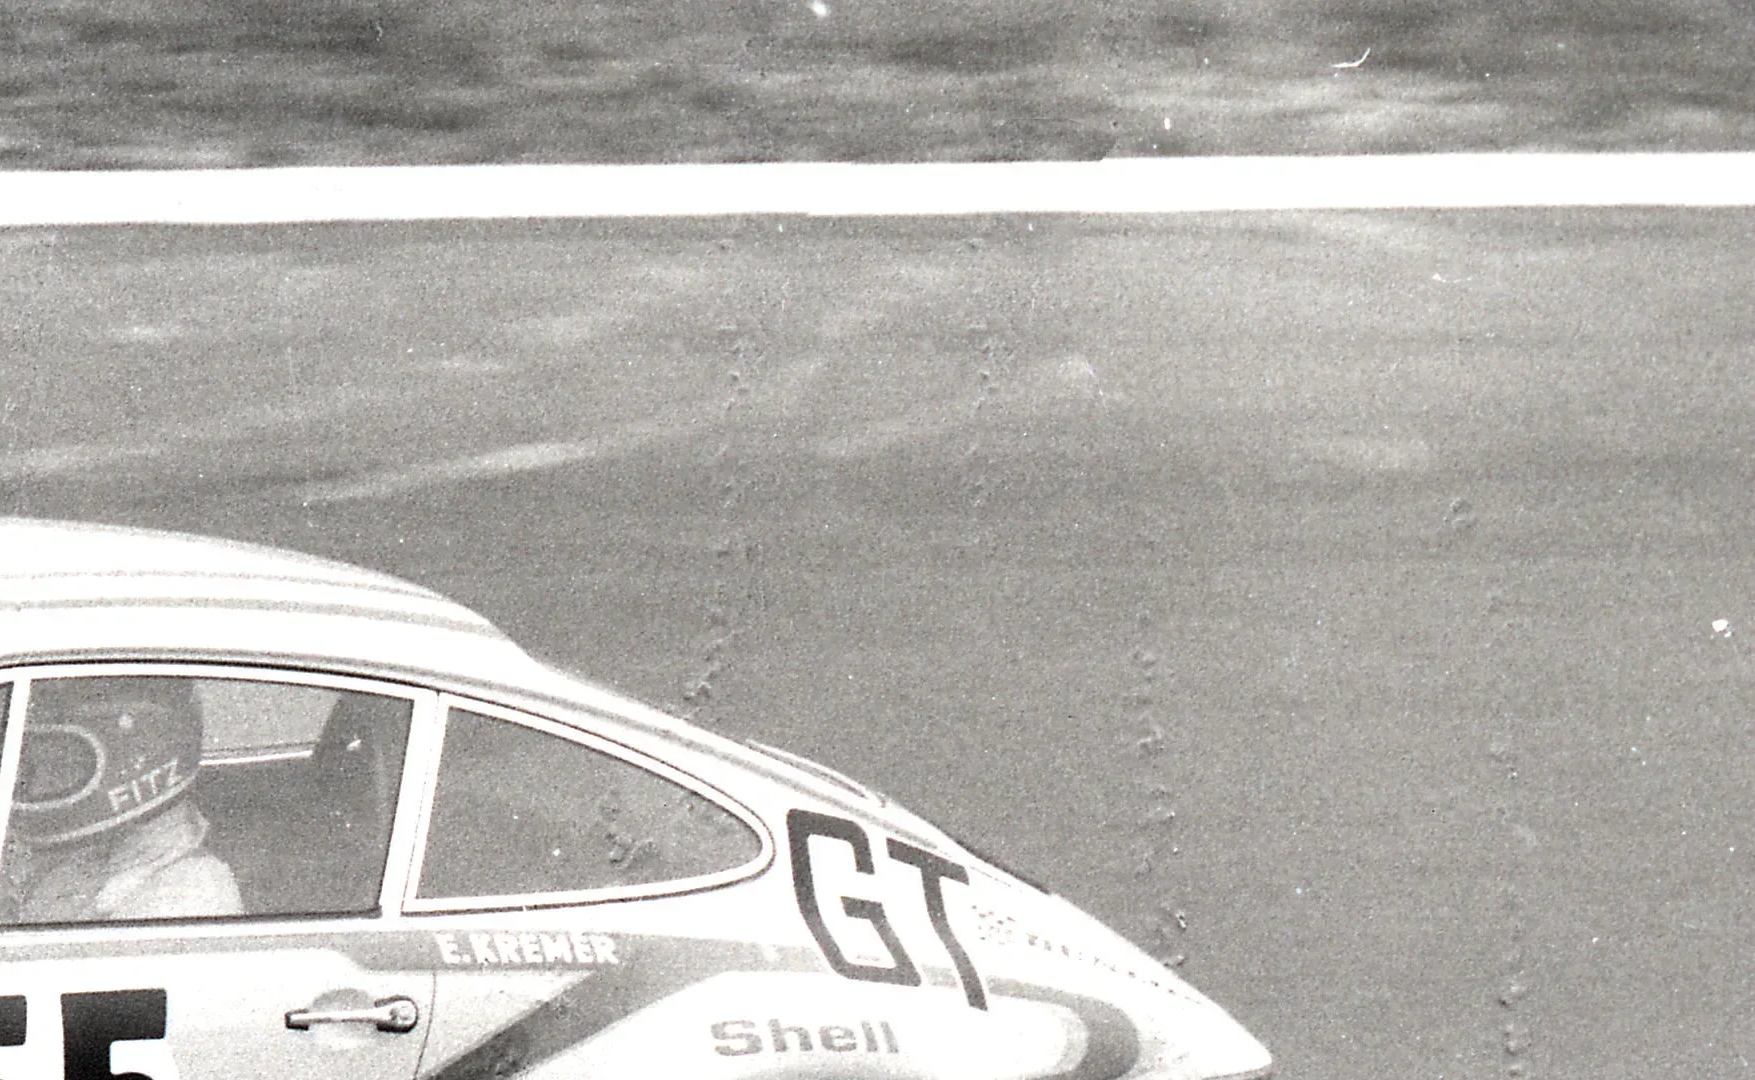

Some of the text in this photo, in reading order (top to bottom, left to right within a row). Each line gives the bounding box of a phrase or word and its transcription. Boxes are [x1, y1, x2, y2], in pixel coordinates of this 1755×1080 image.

[108, 758, 183, 812] FITZ
[785, 807, 989, 1012] GT
[709, 1016, 900, 1057] Shell
